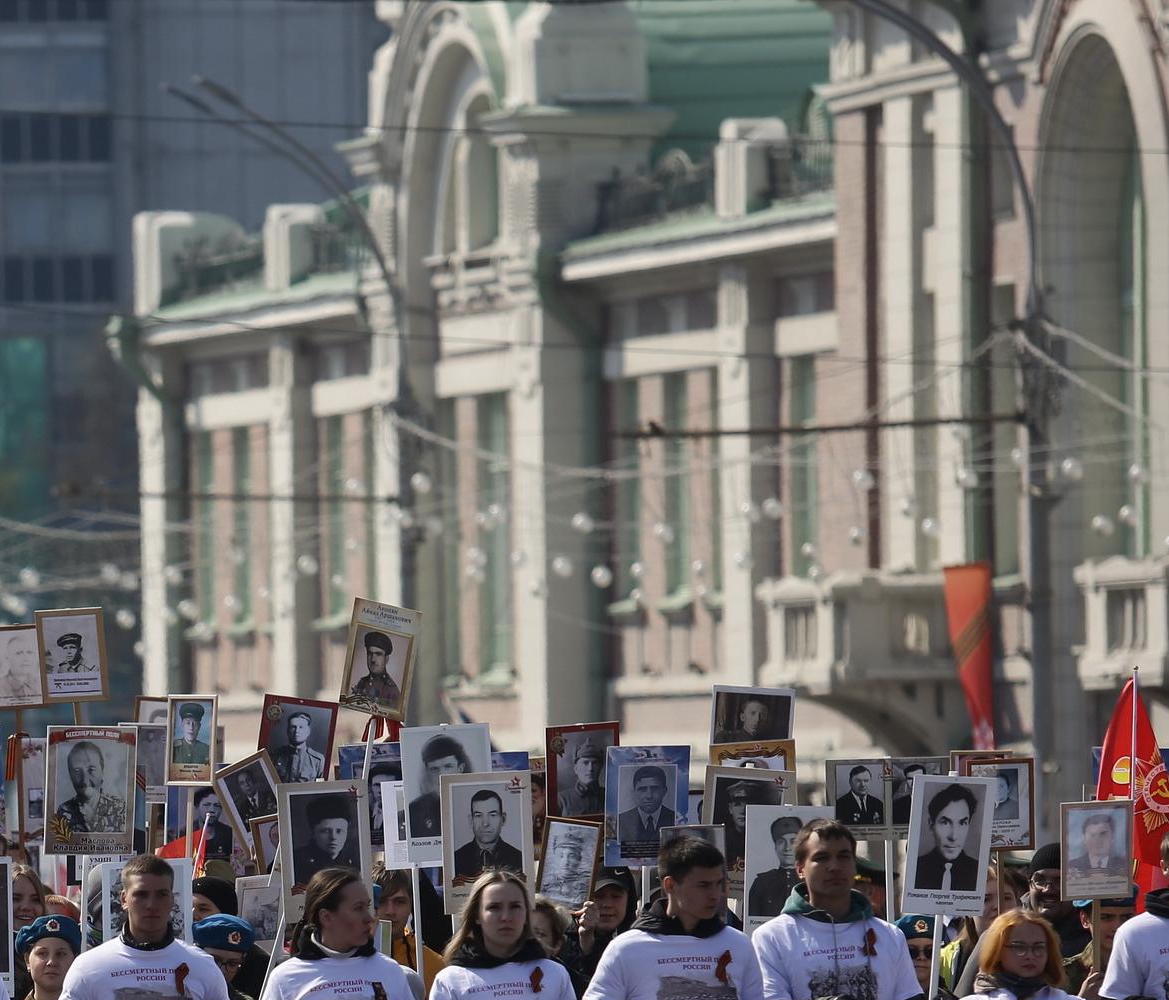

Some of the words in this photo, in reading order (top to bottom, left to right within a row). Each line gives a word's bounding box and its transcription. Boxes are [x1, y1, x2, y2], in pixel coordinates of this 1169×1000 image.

[657, 956, 713, 965] БЕССМЕРТНЫЙ
[827, 953, 855, 961] РОССИИ
[110, 966, 168, 978] БЕССМЕРТНЫЙ
[333, 986, 363, 994] РОССИИ
[493, 990, 524, 998] РОССИИ
